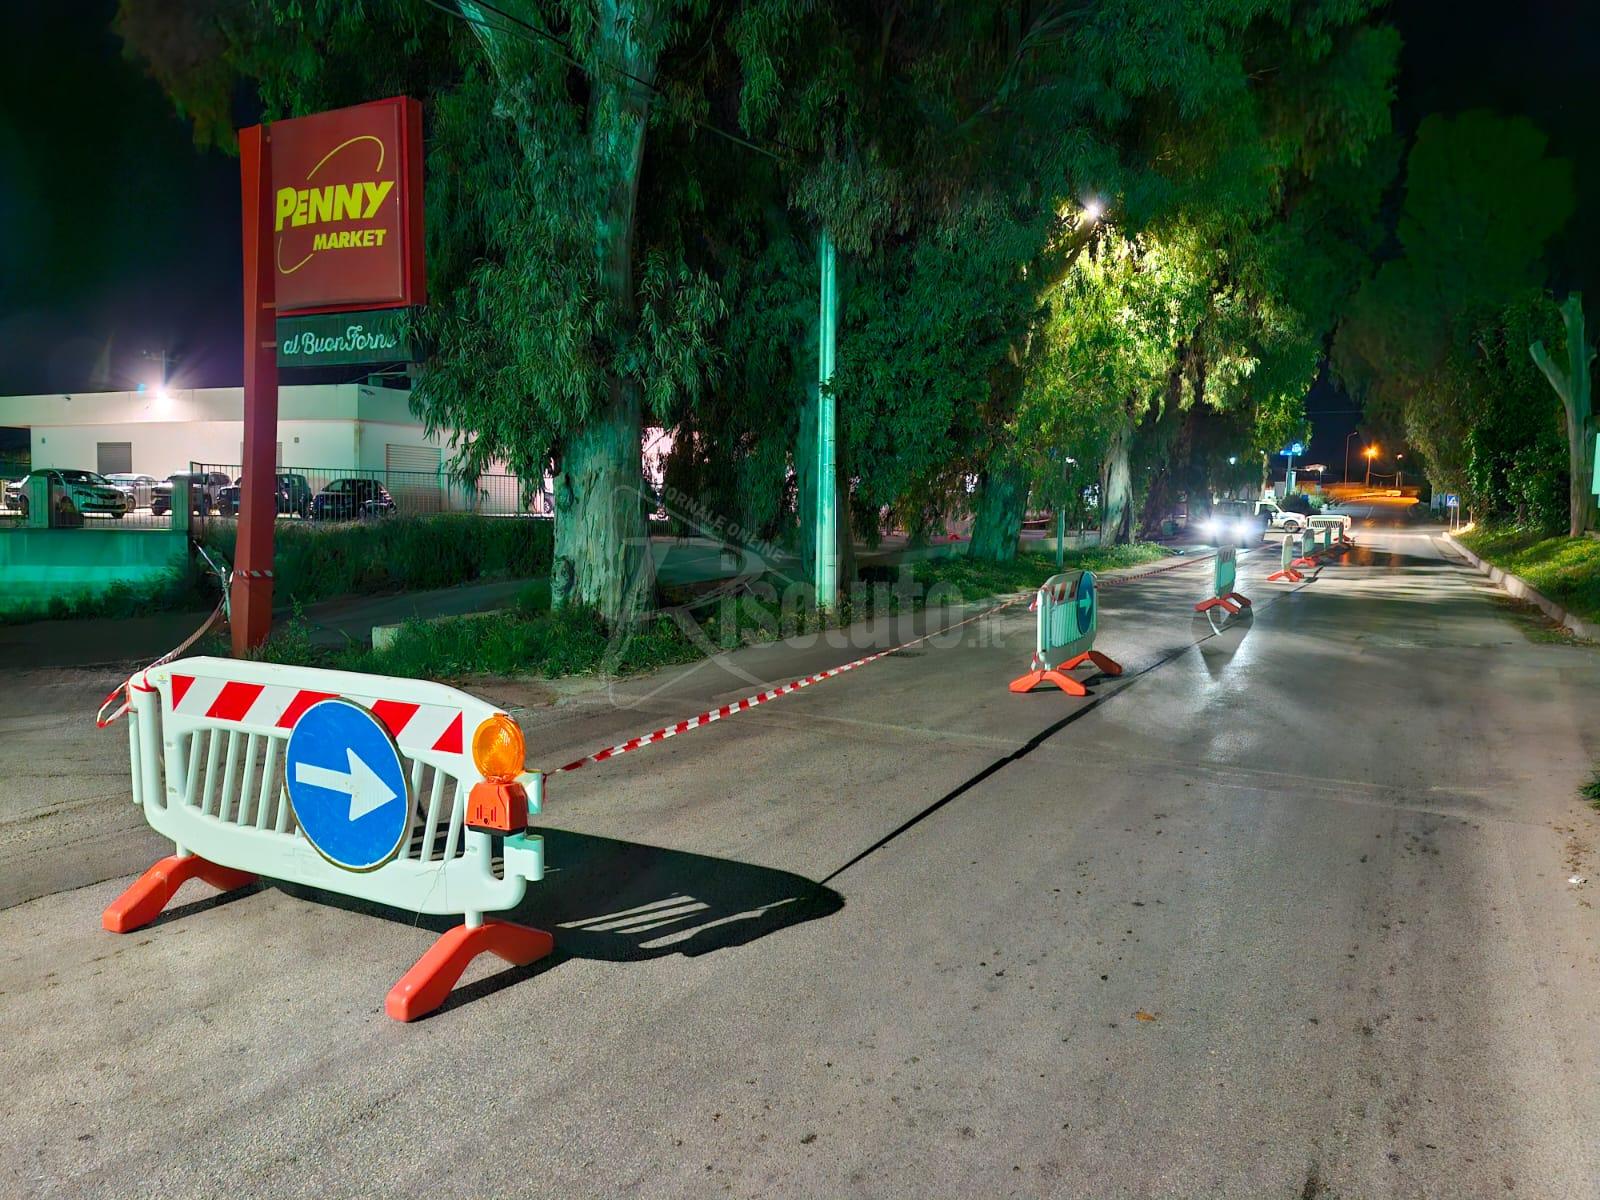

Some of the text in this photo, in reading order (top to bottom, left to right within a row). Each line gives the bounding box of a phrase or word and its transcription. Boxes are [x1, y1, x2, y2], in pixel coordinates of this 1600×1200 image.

[275, 181, 394, 232] PENNY
[313, 229, 387, 251] MARKET
[283, 334, 300, 354] al
[302, 332, 347, 355] Buon
